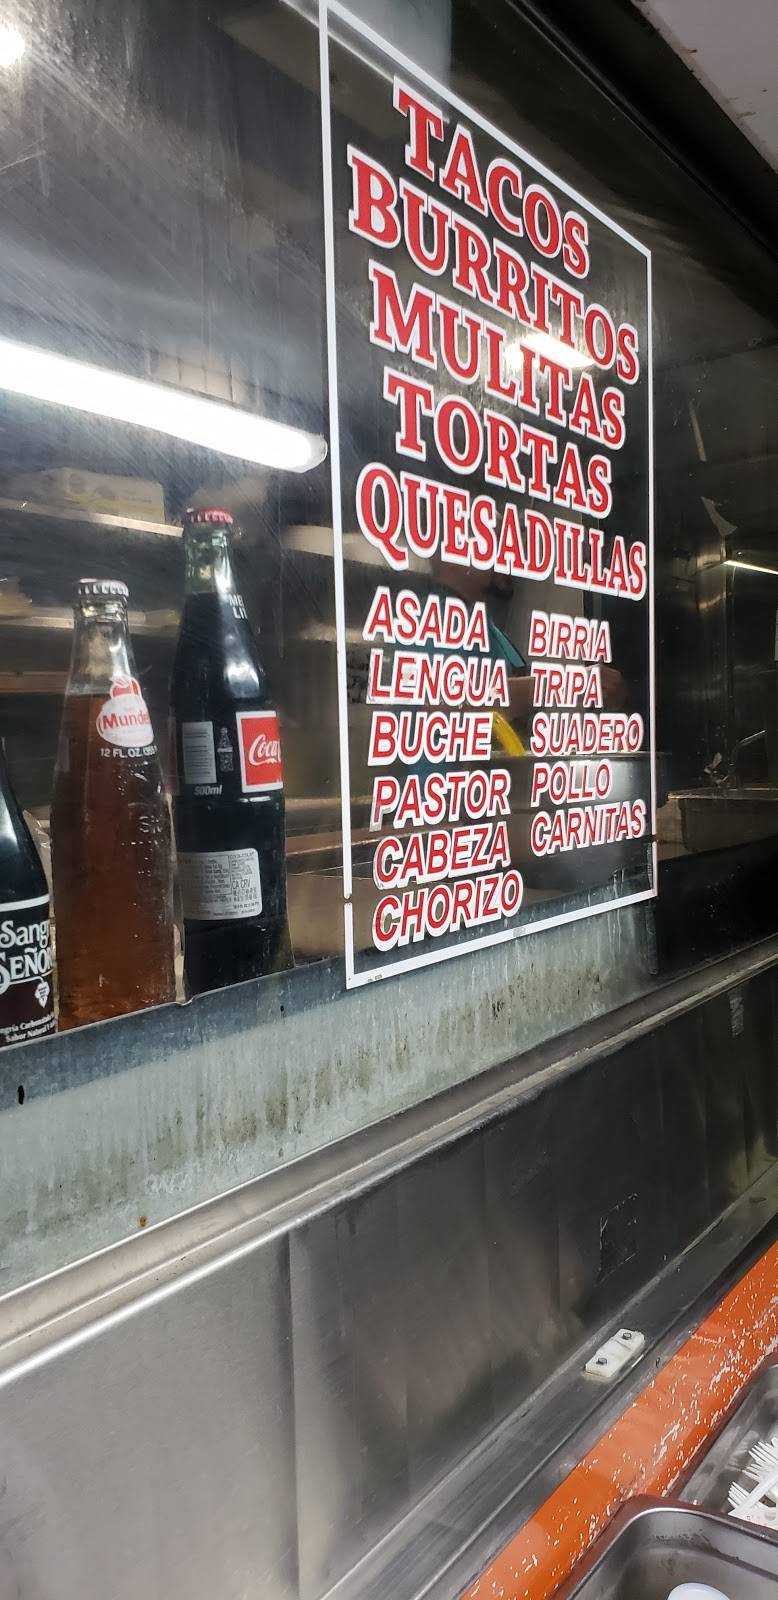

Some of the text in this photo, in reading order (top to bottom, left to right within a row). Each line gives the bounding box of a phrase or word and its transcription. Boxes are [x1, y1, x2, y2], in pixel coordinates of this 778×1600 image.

[393, 75, 590, 279] TACOS
[347, 144, 639, 385] BURRITOS
[368, 259, 625, 450] MULITAS
[383, 367, 612, 519] TORTAS
[356, 463, 647, 600] QUESADILLAS
[363, 586, 490, 653] ASADA
[528, 610, 612, 664] BIRRIA
[366, 648, 510, 708] LENGUA
[531, 662, 604, 708] TRIPA
[100, 747, 111, 758] 12
[368, 710, 493, 766] BUCHE
[530, 712, 643, 757] SUADERO
[370, 768, 511, 831] PASTOR
[531, 758, 613, 807] POLLO
[374, 821, 511, 890] CABEZA
[530, 799, 647, 857] CARNITAS
[372, 868, 523, 952] CHORIZO
